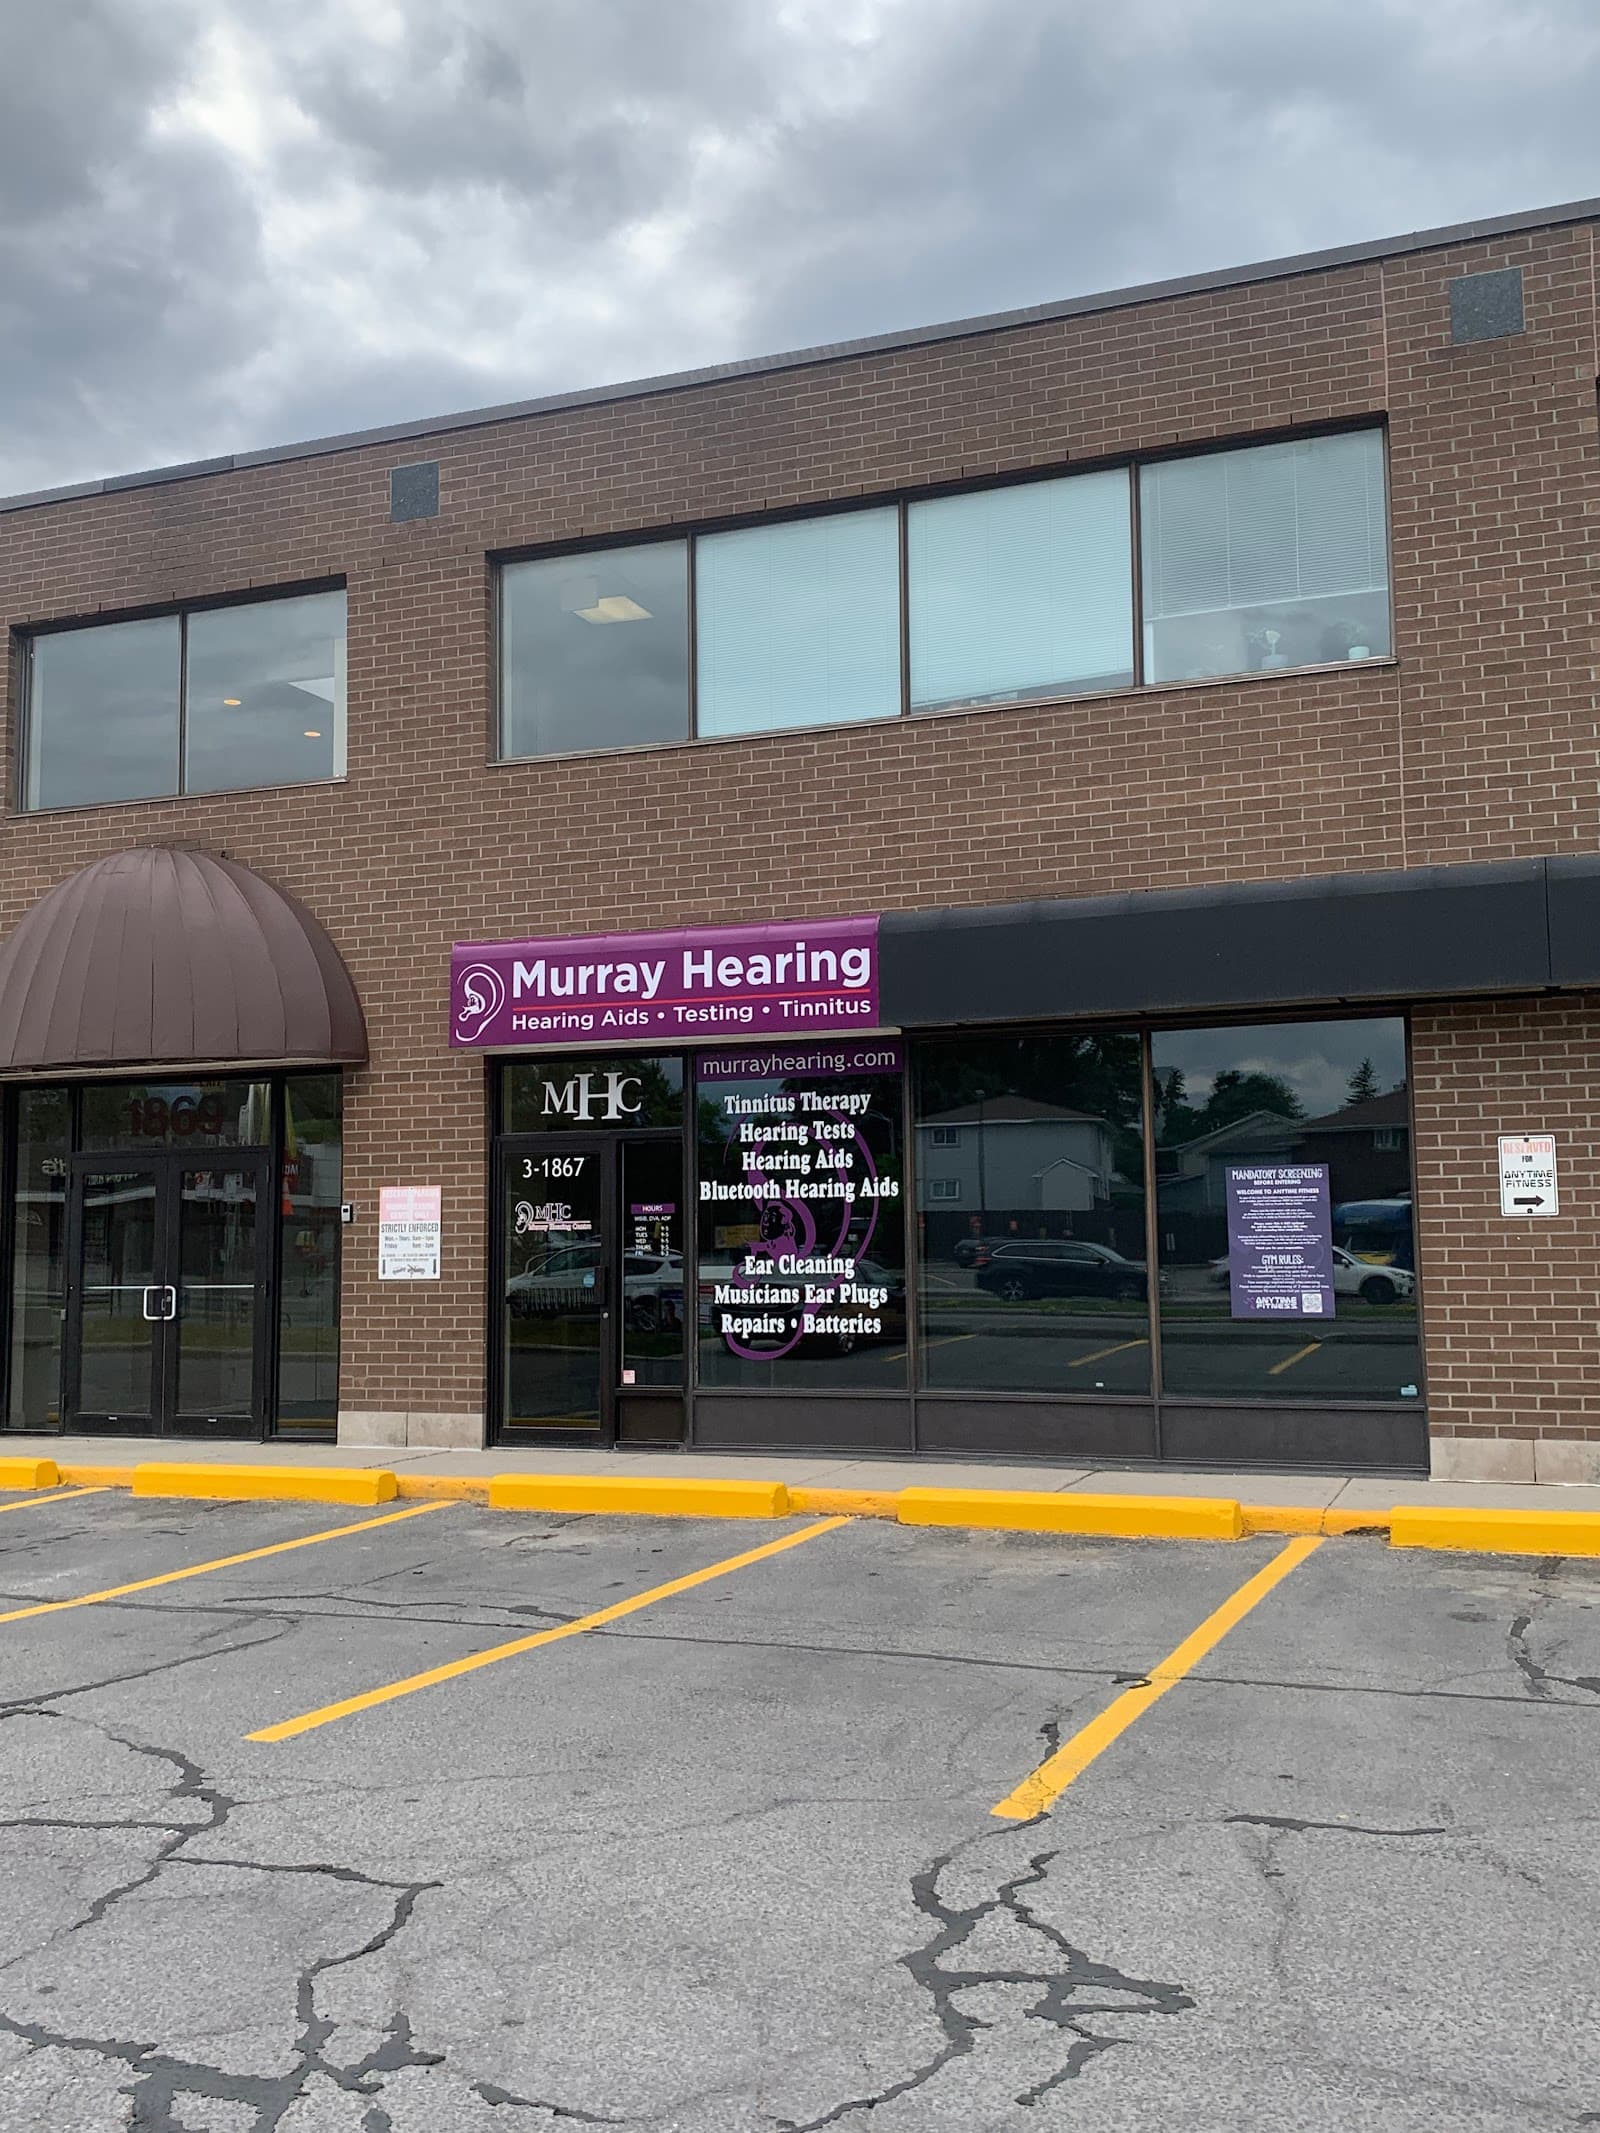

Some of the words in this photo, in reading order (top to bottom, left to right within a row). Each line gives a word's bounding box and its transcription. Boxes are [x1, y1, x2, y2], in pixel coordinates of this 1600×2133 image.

[512, 958, 666, 999] Murray
[683, 942, 871, 989] Hearing
[512, 1012, 594, 1032] Hearing
[601, 1008, 649, 1026] Aids
[673, 1003, 754, 1024] Testing
[779, 998, 872, 1018] Tinnitus
[703, 1051, 896, 1075] murrayhearing.com
[540, 1071, 642, 1121] MHC
[724, 1093, 795, 1115] Tinnitus
[800, 1092, 871, 1115] Therapy
[129, 1096, 226, 1137] 1869
[740, 1122, 808, 1145] Hearing
[812, 1120, 855, 1140] Tests
[522, 1157, 585, 1179] 3-1867
[742, 1151, 810, 1174] Hearing
[815, 1149, 853, 1169] Aids
[1232, 1169, 1276, 1180] MANDATORY
[1278, 1168, 1323, 1179] SCREENING
[1504, 1169, 1553, 1178] ANYTIME
[700, 1181, 780, 1201] Bluetooth
[785, 1179, 855, 1202] Hearing
[860, 1176, 899, 1198] Aids
[1505, 1179, 1552, 1188] FITNESS
[535, 1203, 571, 1221] MHC
[381, 1224, 407, 1233] STRICTLY
[408, 1223, 438, 1233] ENFORCED
[744, 1256, 773, 1275] Ear
[778, 1254, 855, 1279] Cleaning
[1261, 1255, 1278, 1264] GYM
[714, 1284, 799, 1305] Musicians
[804, 1284, 834, 1304] Ear
[839, 1283, 888, 1308] Plugs
[721, 1313, 785, 1338] Repairs
[803, 1313, 881, 1334] Batteries
